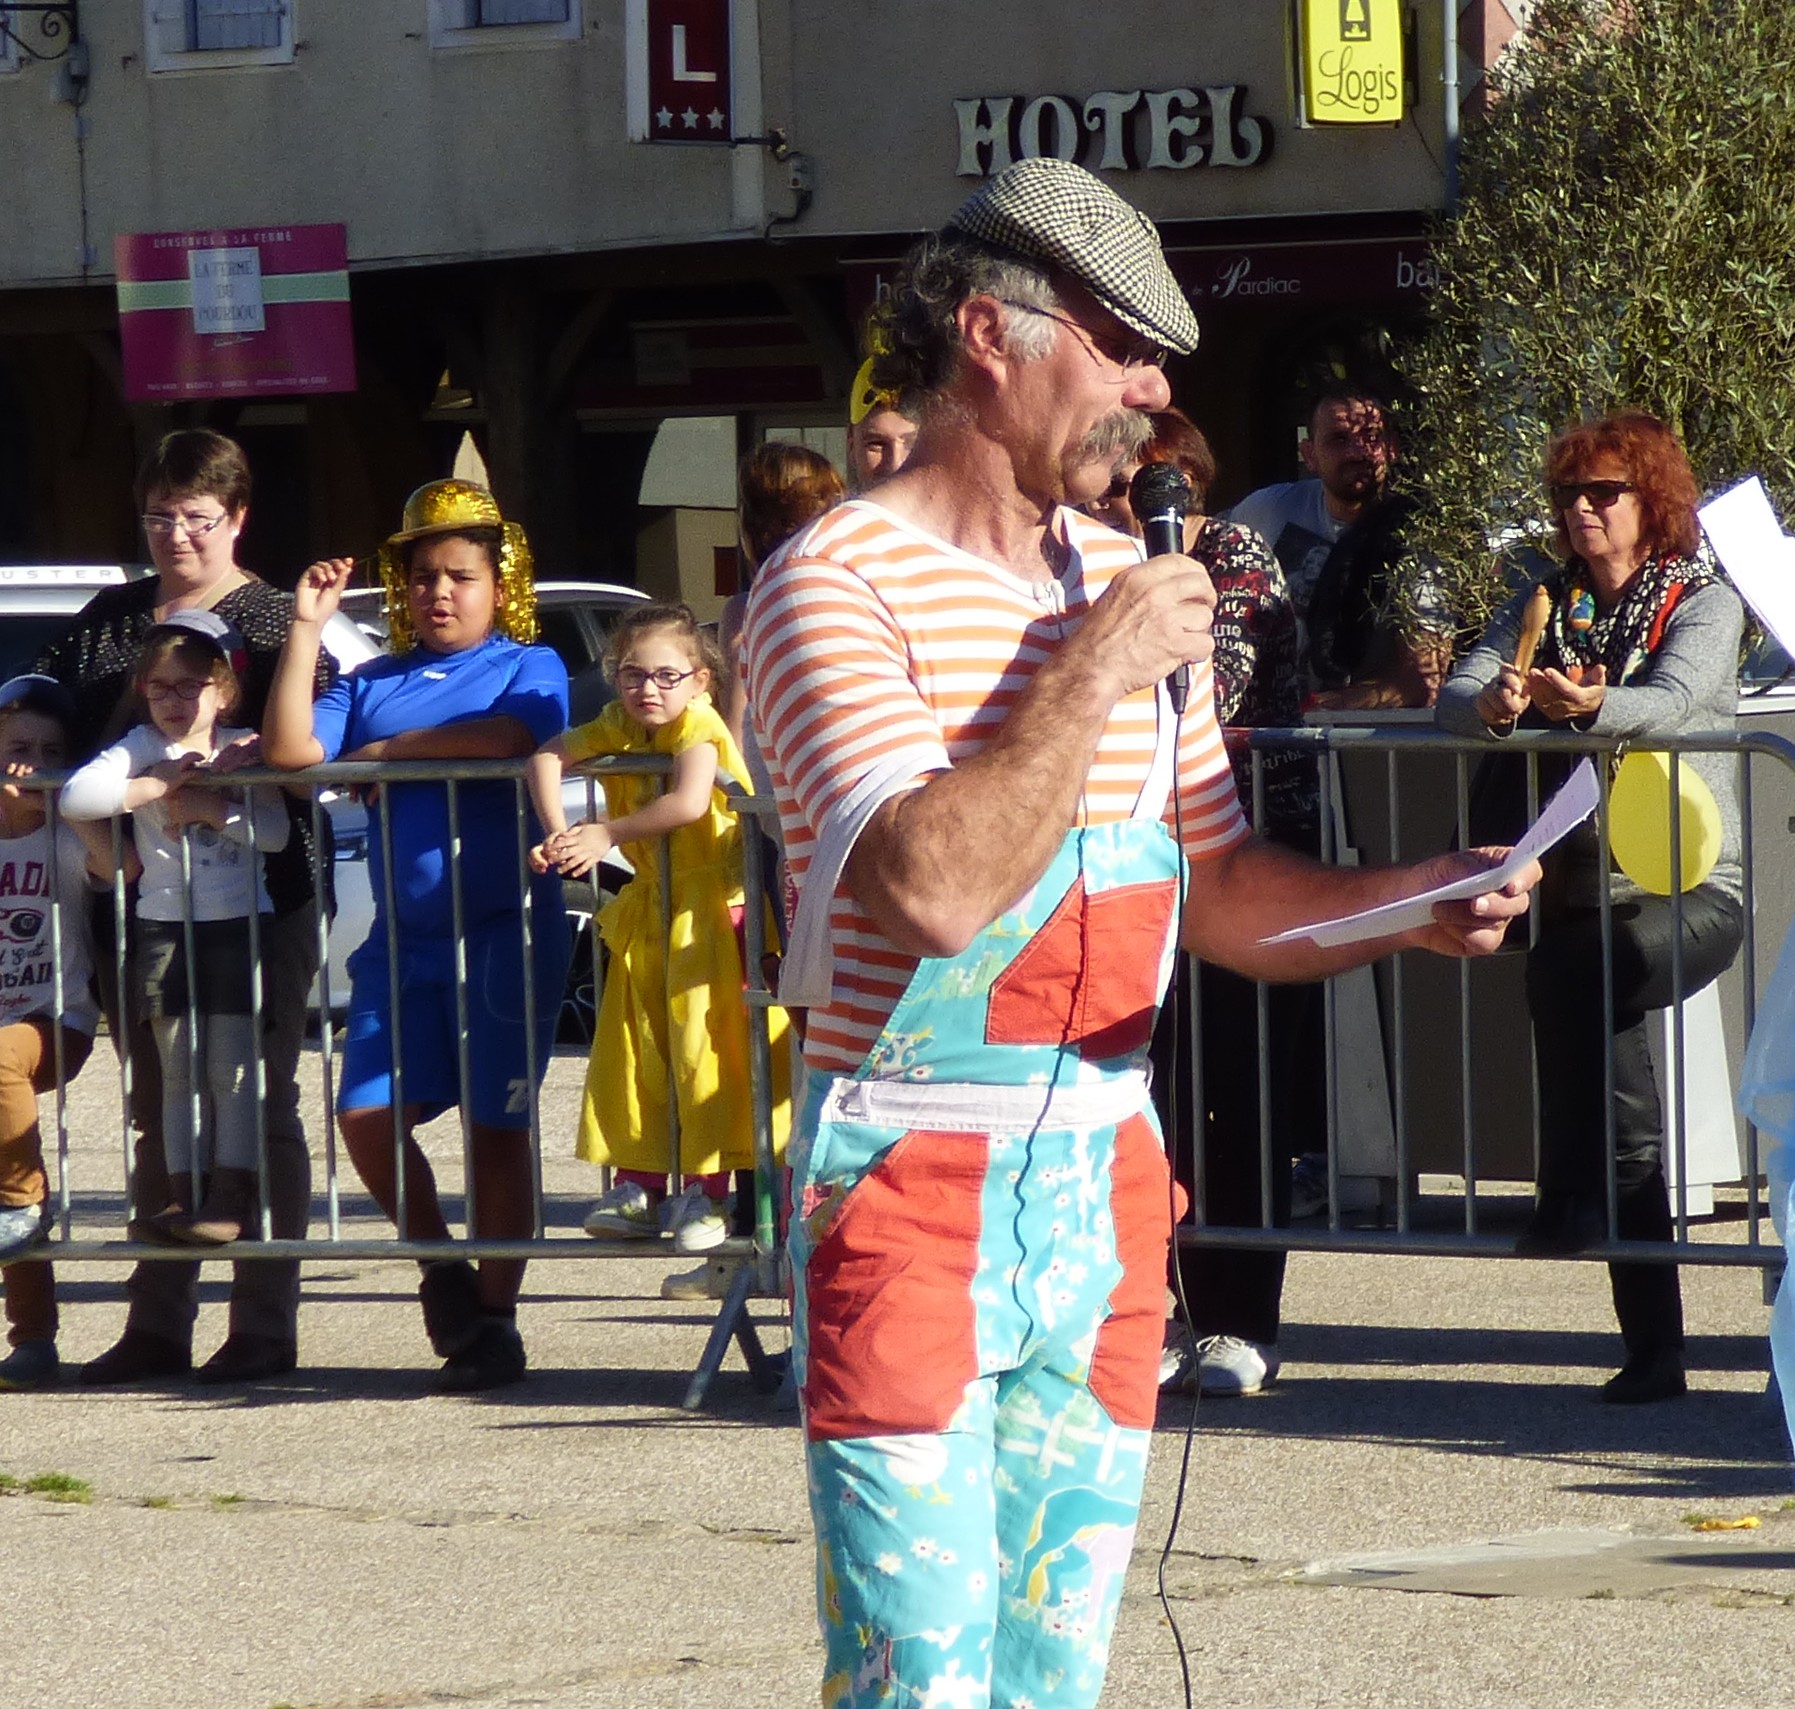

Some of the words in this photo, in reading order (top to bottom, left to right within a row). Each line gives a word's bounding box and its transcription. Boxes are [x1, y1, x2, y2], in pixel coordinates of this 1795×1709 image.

[1316, 45, 1398, 115] Logis
[953, 86, 1263, 176] HOTEL
[1211, 254, 1301, 299] Pardiac
